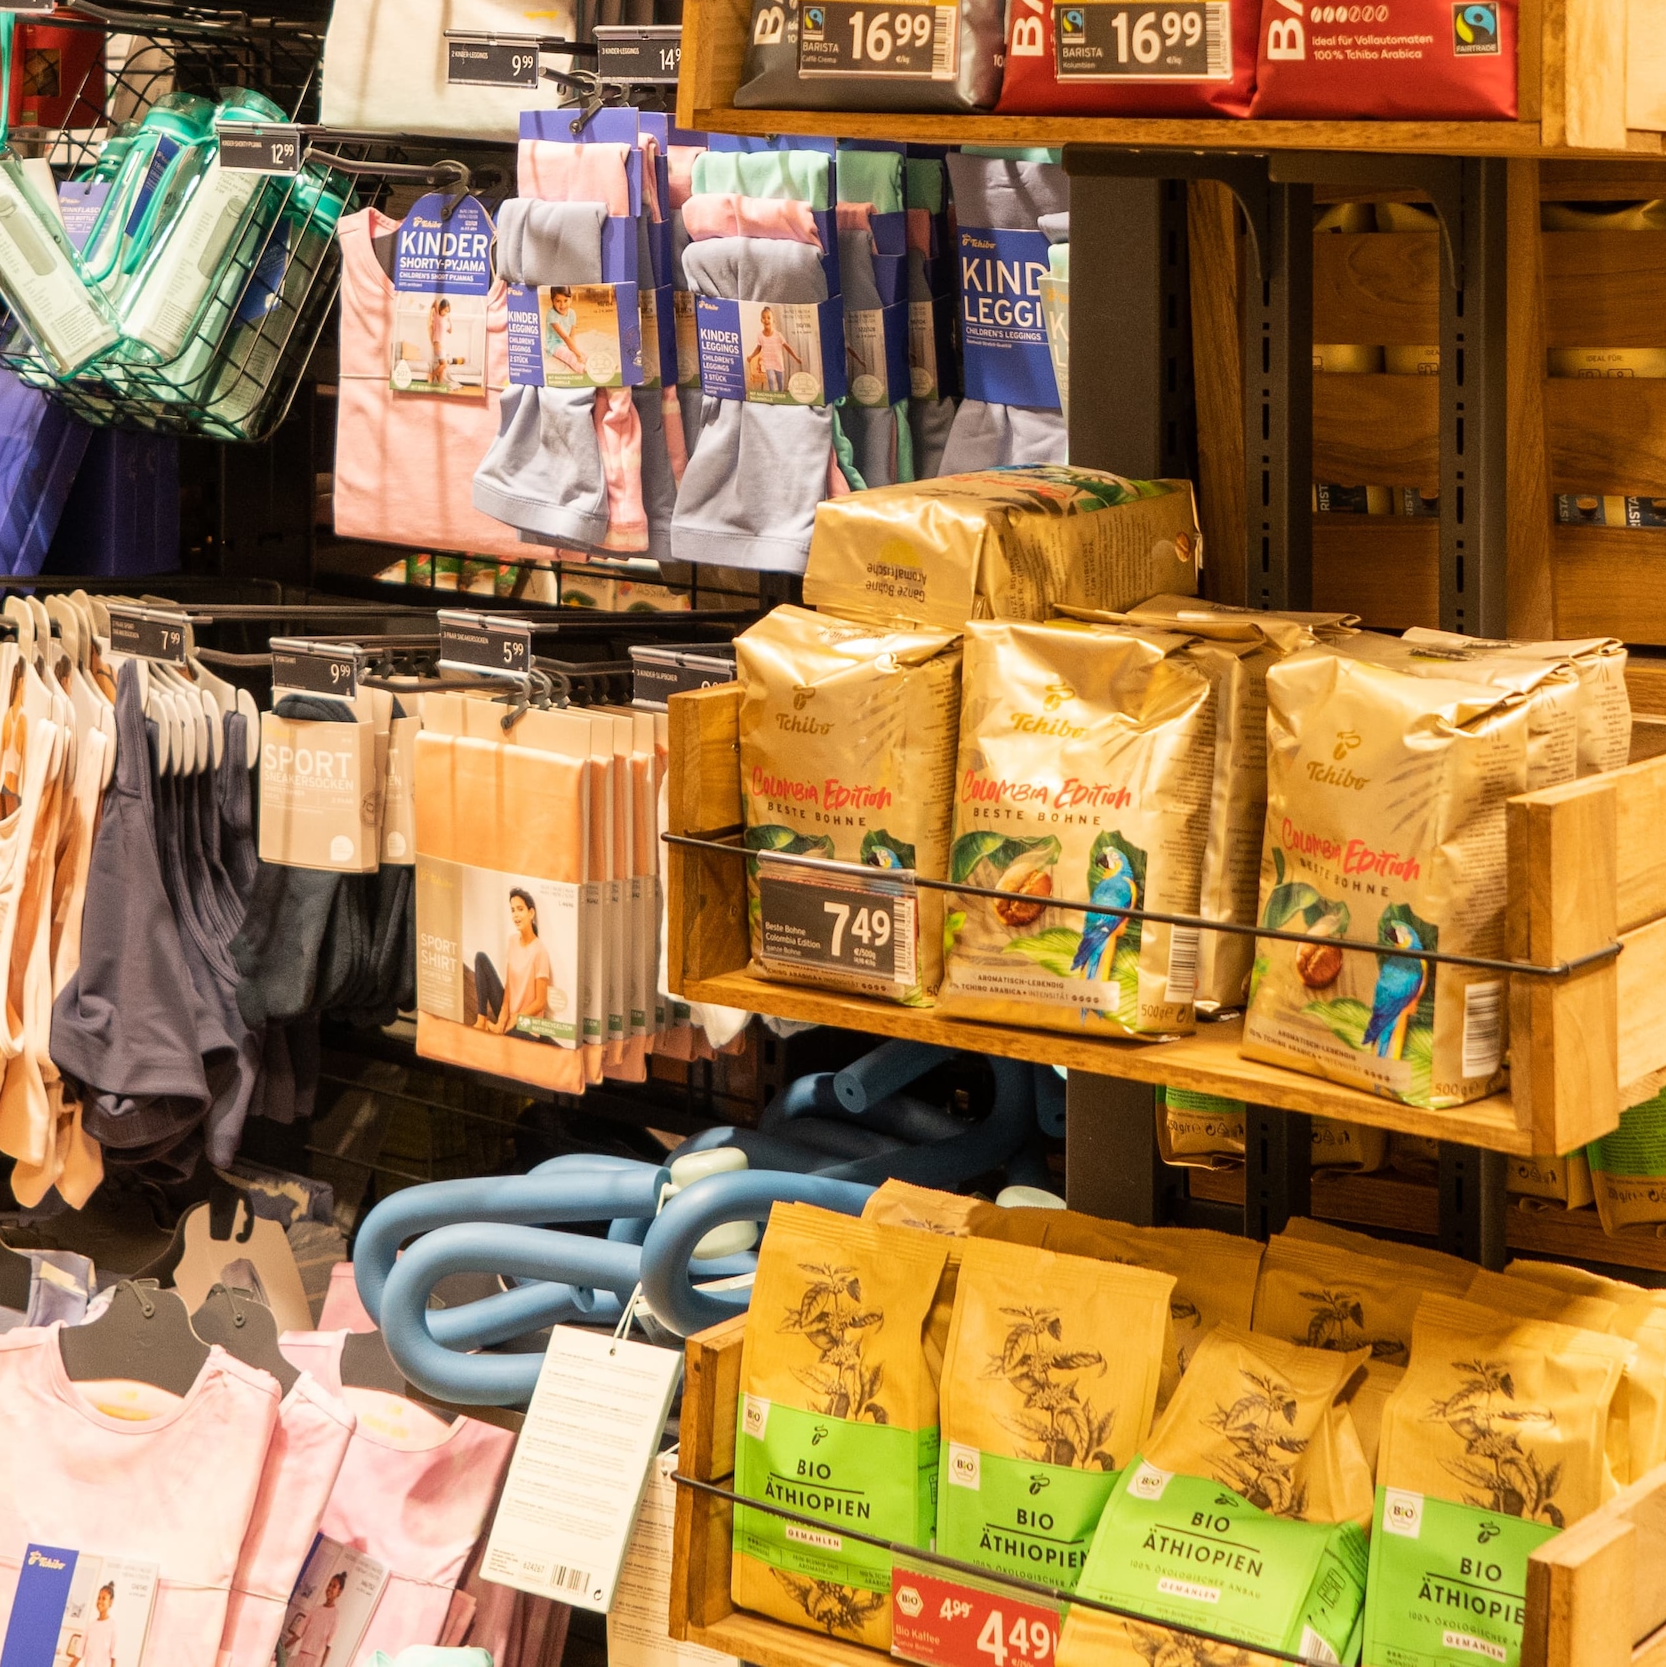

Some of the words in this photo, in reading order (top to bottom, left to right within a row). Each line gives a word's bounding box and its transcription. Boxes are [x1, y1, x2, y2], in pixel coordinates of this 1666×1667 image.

[401, 232, 488, 258] KINDER
[400, 257, 486, 272] SHORTY-PYJAMA
[701, 329, 739, 344] KINDER
[702, 341, 739, 354] LEGGINGS
[1011, 713, 1087, 737] Tchibo
[264, 750, 353, 778] SPORT
[1307, 760, 1371, 790] Tchibo
[264, 770, 354, 791] SNEAKERSOCKEN
[768, 802, 806, 819] BESTE
[815, 811, 866, 827] BOHNE
[974, 808, 1024, 820] BESTE
[1038, 812, 1100, 826] BOHNE
[1300, 857, 1331, 881] BESTE
[1334, 871, 1389, 897] BOHNE
[765, 921, 782, 932] Beste
[785, 924, 806, 935] Bohne
[421, 933, 457, 957] SPORT
[765, 933, 794, 946] Colombia
[797, 938, 821, 949] Edition
[421, 951, 457, 972] SHIRT
[797, 1458, 831, 1480] BIO
[765, 1475, 870, 1520] ÄTHIOPIEN
[1017, 1508, 1055, 1531] BIO
[1191, 1511, 1231, 1533] BIO
[787, 1528, 841, 1549] GEMAHLEN
[1143, 1528, 1263, 1578] ÄTHIOPIEN
[1460, 1557, 1502, 1582] BIO
[1159, 1580, 1218, 1603] GEMAHLEN
[1419, 1577, 1525, 1625] ÄTHIOPIE
[896, 1623, 913, 1638] Bio
[915, 1630, 940, 1647] Kaffee
[1446, 1635, 1504, 1659] GEMAHLEN
